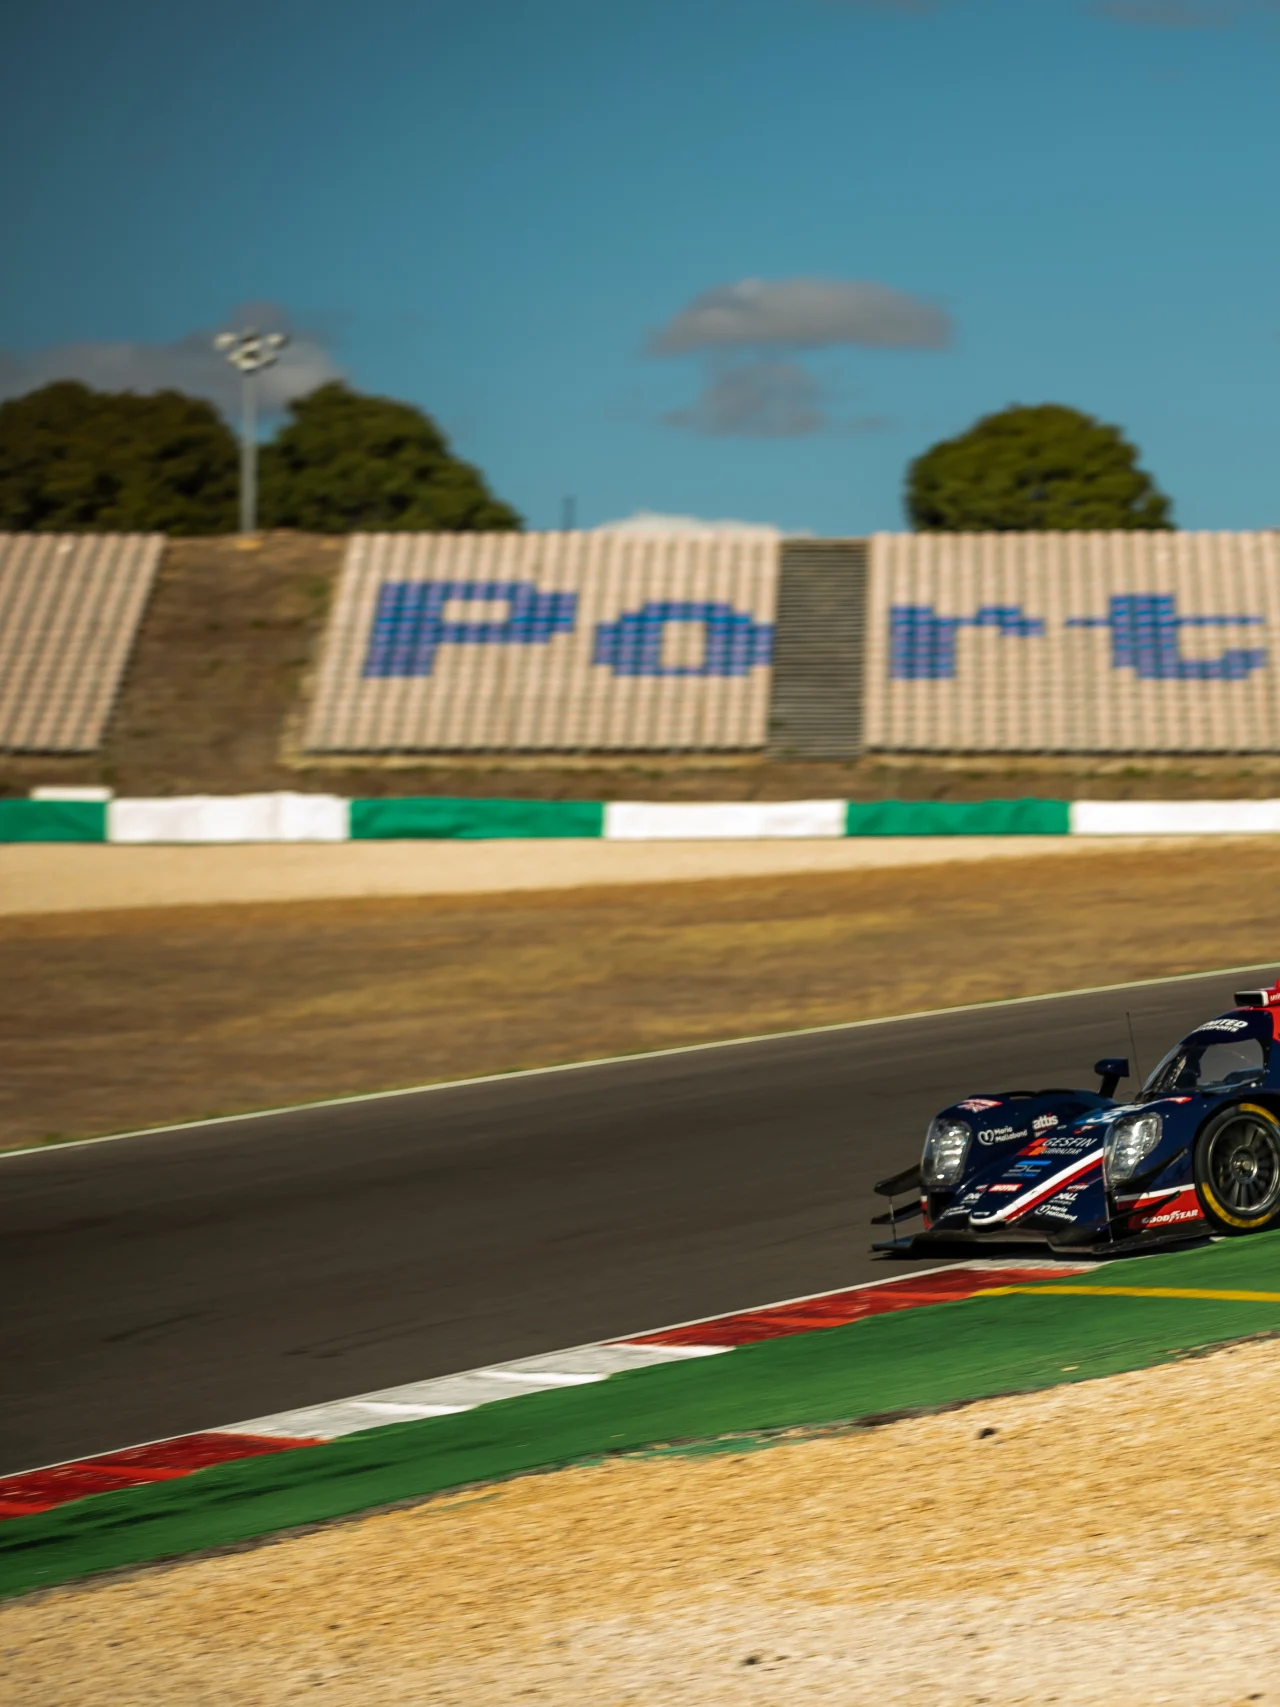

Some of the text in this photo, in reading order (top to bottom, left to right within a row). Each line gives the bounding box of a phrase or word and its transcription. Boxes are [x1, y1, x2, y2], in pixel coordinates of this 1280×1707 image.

[1032, 1112, 1059, 1130] attis
[994, 1126, 1013, 1135] Maria
[1042, 1137, 1098, 1147] GESFIN
[1141, 1209, 1199, 1224] GOODYEAR
